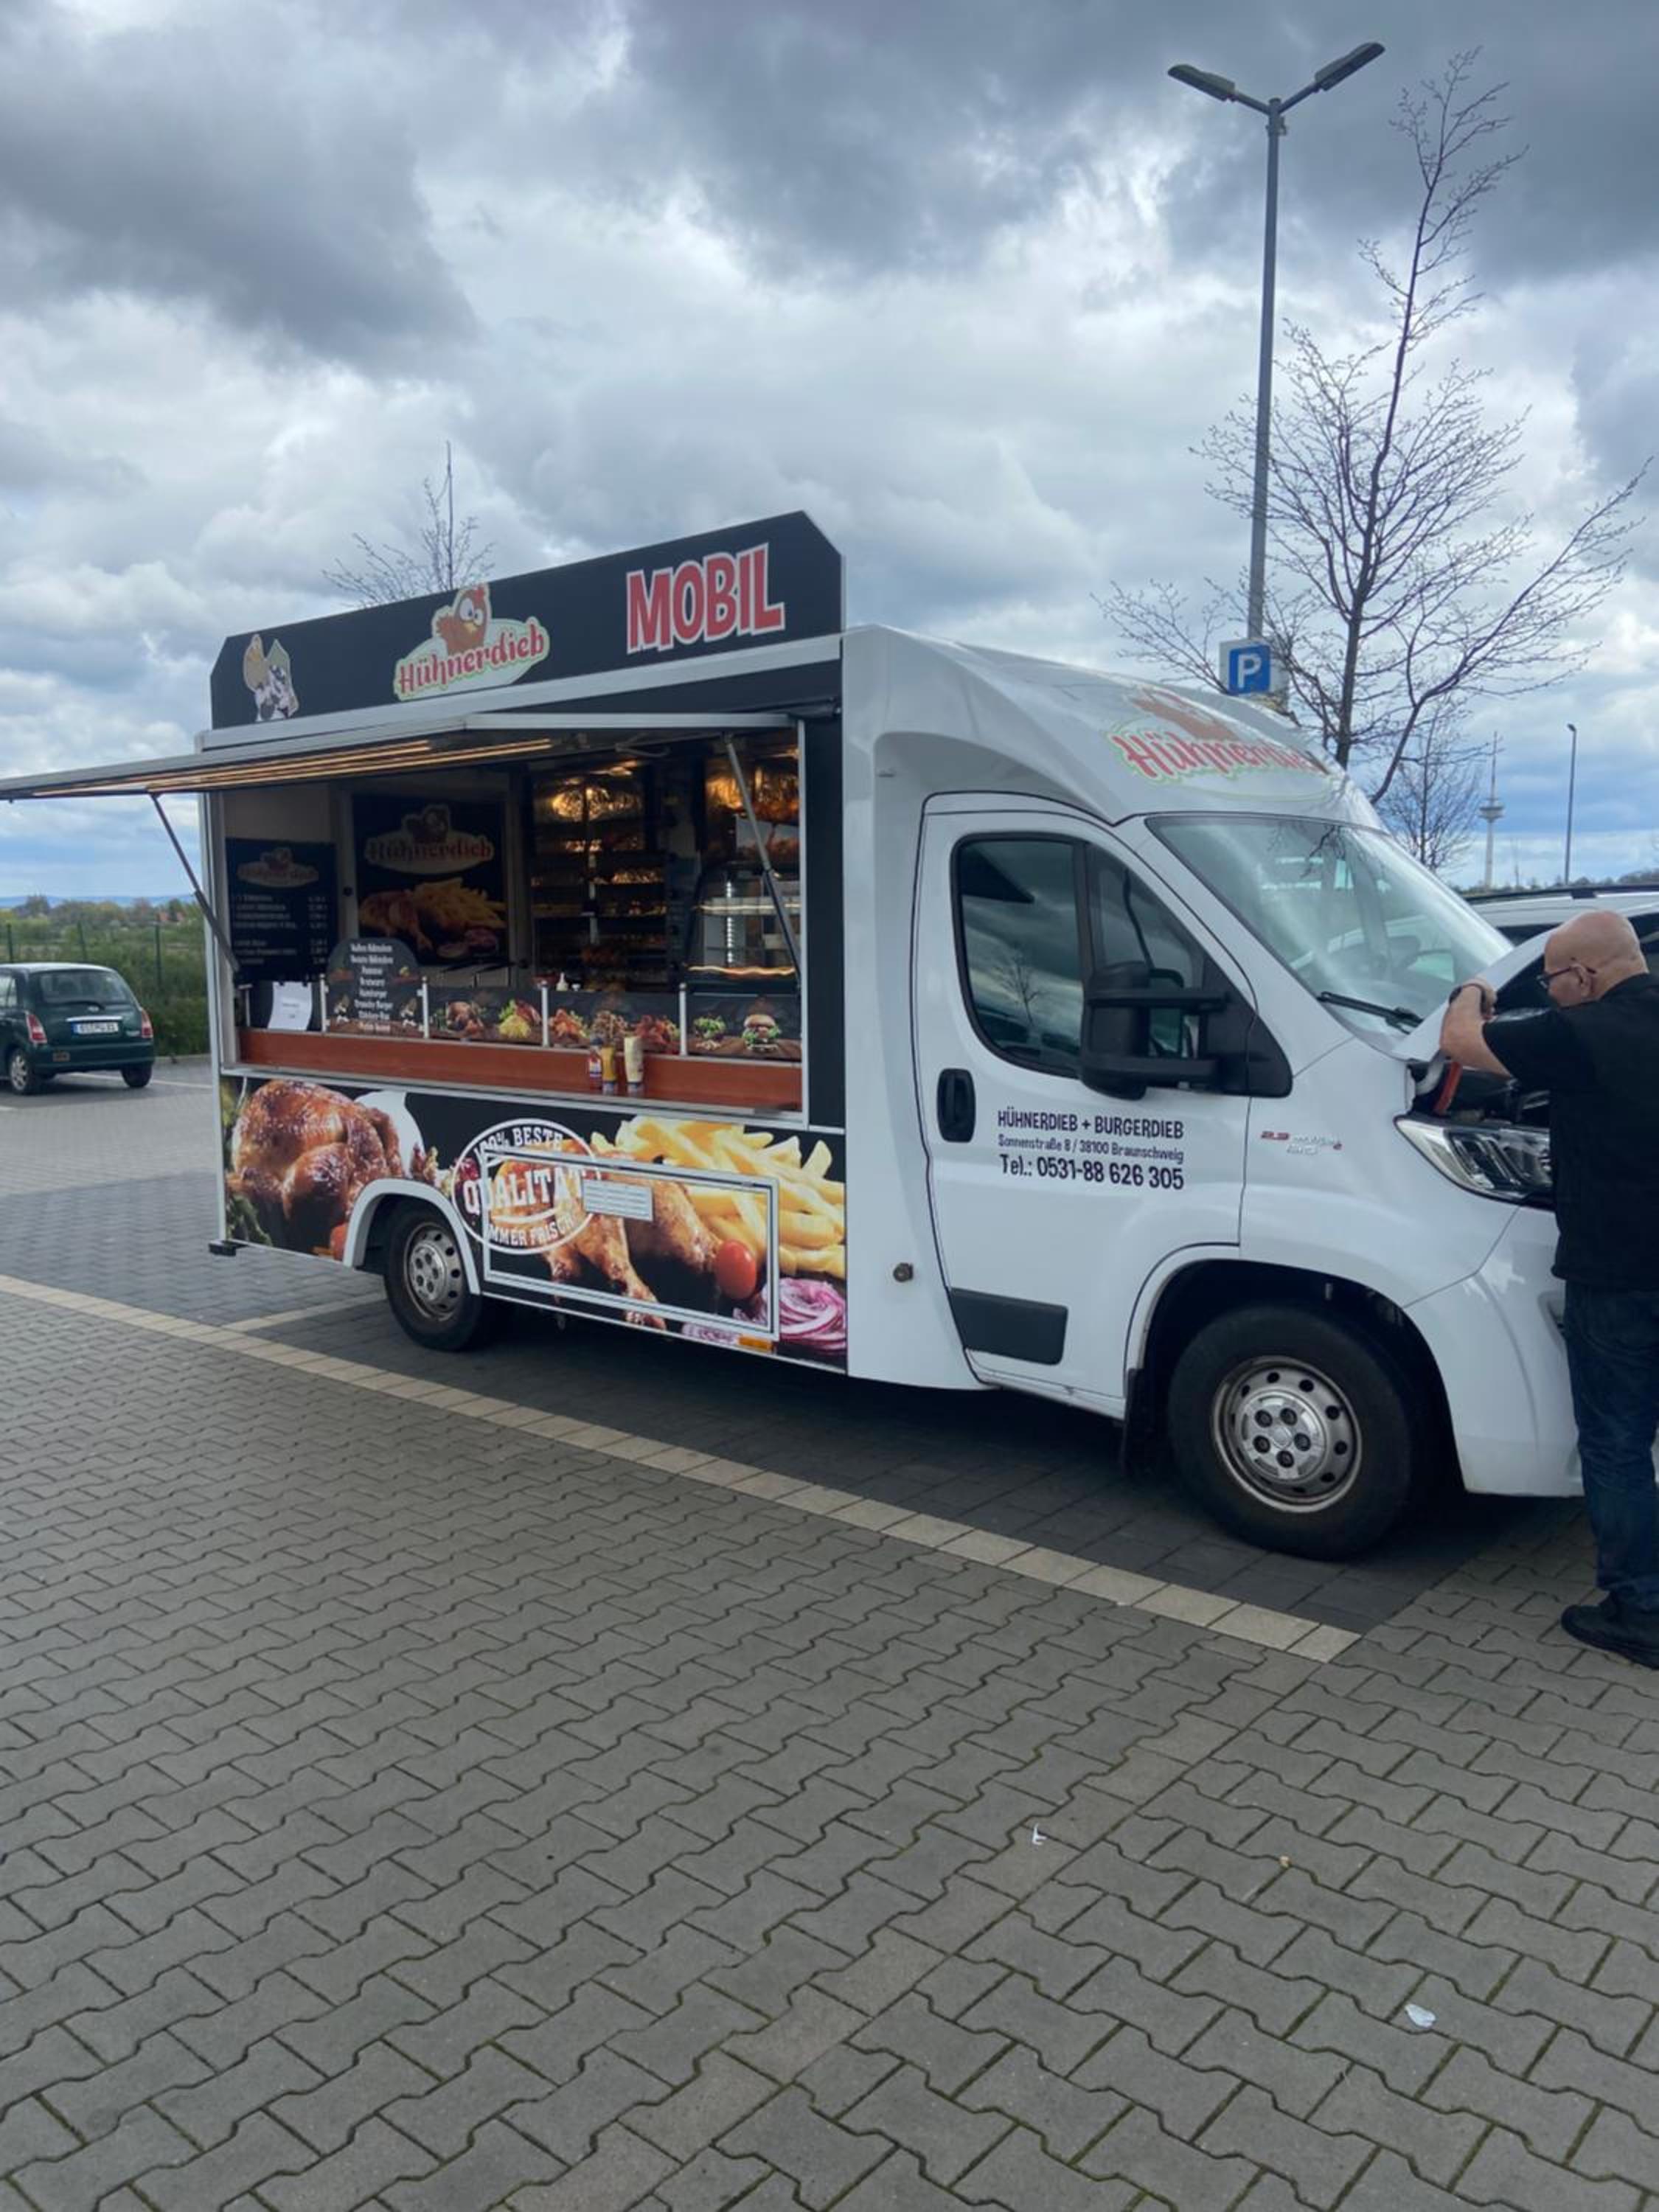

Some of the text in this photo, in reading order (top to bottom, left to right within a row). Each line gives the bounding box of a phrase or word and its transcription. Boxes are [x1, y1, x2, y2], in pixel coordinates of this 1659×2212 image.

[398, 542, 785, 695] Hühnerdieb MOBIL
[1237, 653, 1262, 689] P
[998, 1105, 1078, 1132] HÜHNERDIEB
[1095, 1115, 1184, 1139] BURGERDIEB
[1064, 1138, 1071, 1152] 8
[1079, 1139, 1110, 1155] 38100
[999, 1153, 1184, 1190] Tel.: 0531-88 626 305
